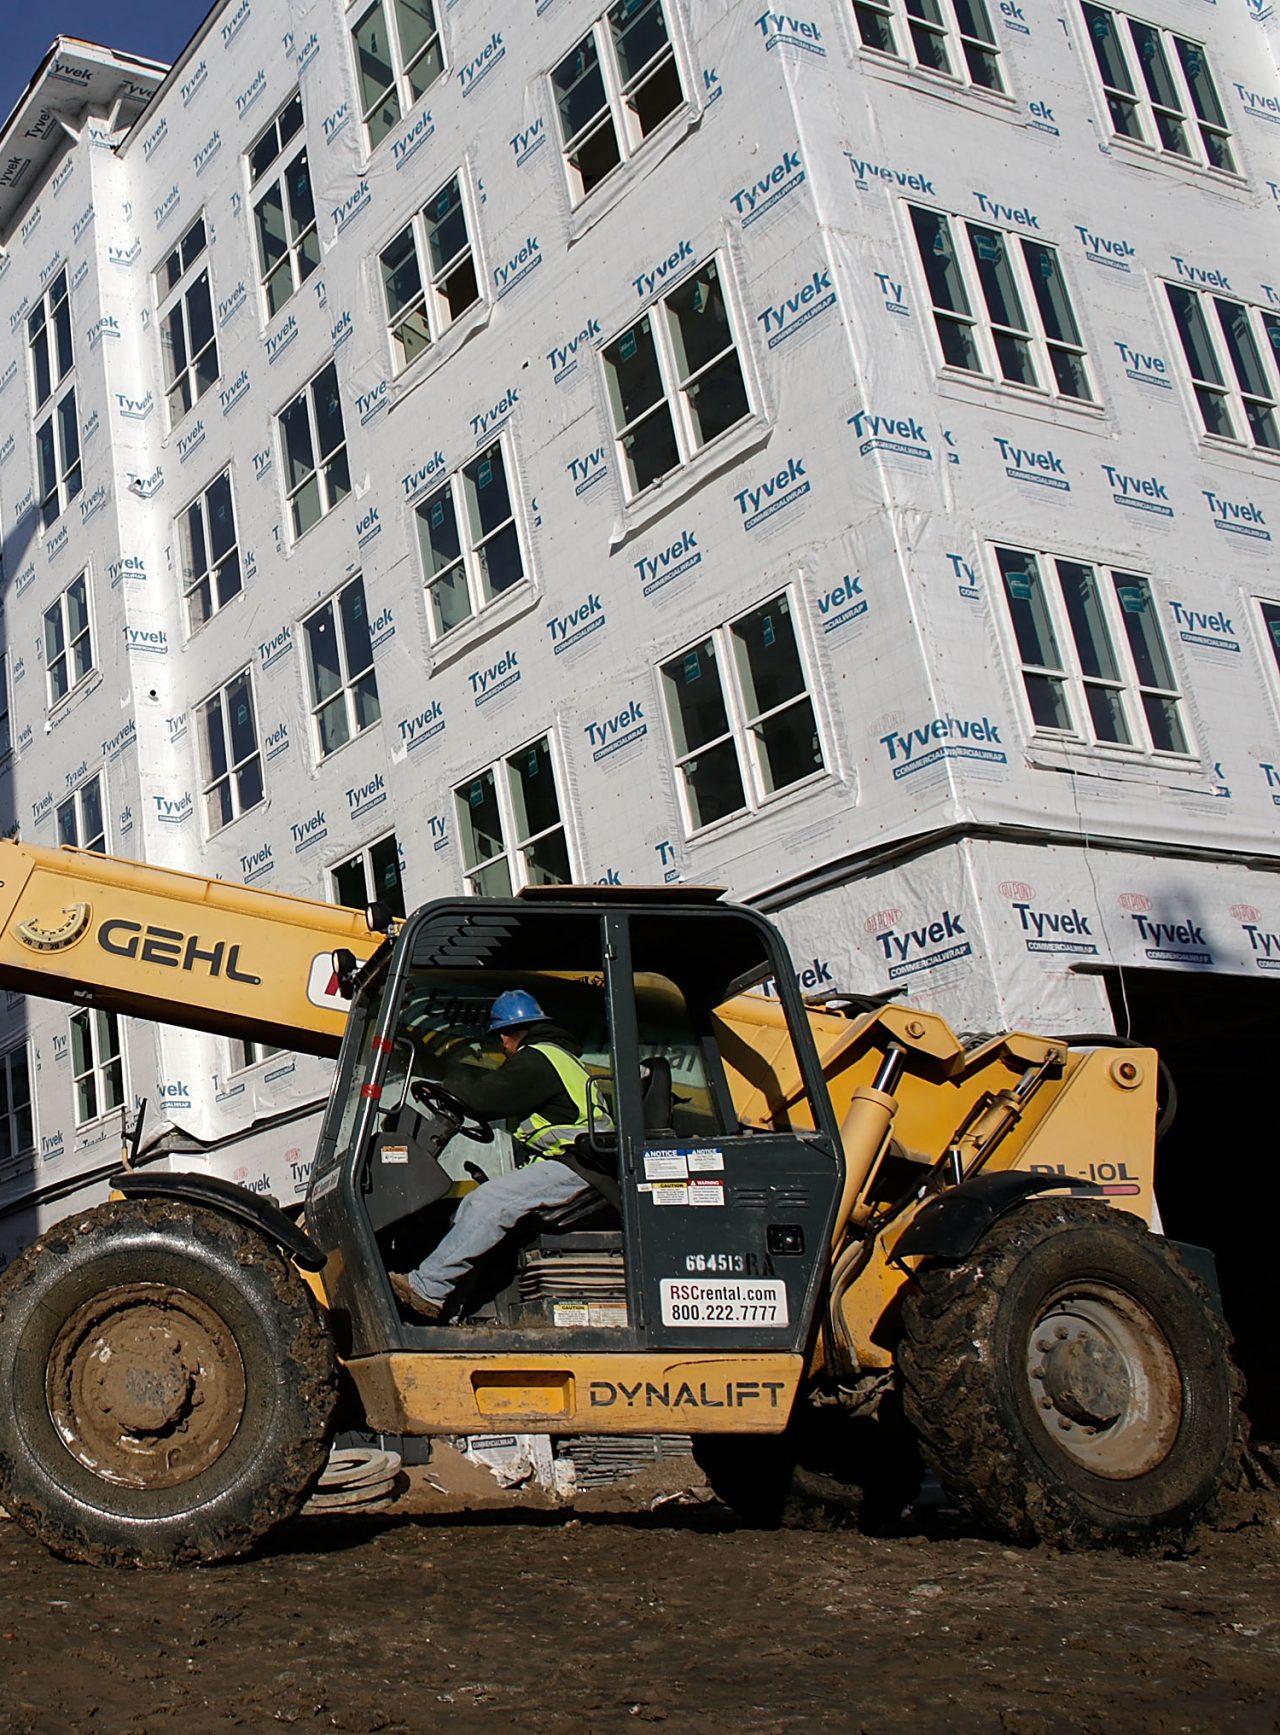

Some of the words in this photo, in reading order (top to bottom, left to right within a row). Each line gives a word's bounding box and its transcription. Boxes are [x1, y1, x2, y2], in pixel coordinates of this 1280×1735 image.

[755, 10, 822, 41] Tyvek
[456, 32, 504, 86] Tyvek
[180, 61, 207, 100] Tyvek
[236, 68, 265, 110] Tyvek
[193, 129, 220, 169] Tyvek
[391, 109, 433, 159] Tyvek
[730, 151, 801, 214] Tyvek
[154, 185, 180, 222] Tyvek
[331, 180, 370, 225] Tyvek
[972, 192, 1040, 230] Tyvek
[1075, 225, 1136, 257] Tyvek
[493, 237, 540, 287] Tyvek
[632, 240, 694, 297] Tyvek
[1171, 256, 1232, 290] Tyvek
[757, 271, 833, 333] Tyvek
[86, 316, 119, 343] Tyvek
[264, 314, 297, 354] Tyvek
[547, 318, 602, 371] Tyvek
[1114, 342, 1166, 373] Tyve
[115, 391, 152, 411] Tyvek
[220, 370, 248, 407] Tyvek
[470, 388, 521, 434] Tyvek
[847, 410, 928, 442] Tyvek
[176, 420, 204, 454] Tyvek
[401, 450, 445, 495] Tyvek
[993, 437, 1065, 474] Tyvek
[733, 457, 807, 514] Tyvek
[1101, 464, 1168, 500] Tyvek
[1202, 490, 1266, 525] Tyvek
[46, 525, 68, 554] Tyvek
[634, 530, 698, 582] Tyvek
[15, 562, 35, 590] Tyvek
[107, 556, 145, 579] Tyvek
[946, 553, 975, 586] Ty
[817, 575, 864, 614] vek
[546, 594, 603, 640] Tyvek
[1169, 601, 1235, 635] Tyvek
[122, 626, 167, 645] Tyvek
[259, 625, 291, 659] Tyvek
[469, 650, 518, 693] Tyvek
[398, 700, 443, 740] Tyvek
[584, 701, 645, 746] Tyvek
[32, 792, 54, 817] Tyvek
[154, 791, 192, 815] Tyvek
[346, 773, 385, 808] Tyvek
[290, 810, 326, 842] Tyvek
[427, 816, 445, 837] Ty
[240, 843, 272, 873] Tyvek
[876, 911, 966, 960] Tyvek
[1012, 903, 1092, 937] Tyvek
[1132, 914, 1207, 946] Tyvek
[97, 919, 261, 985] GEHL
[889, 942, 971, 980] COMMERCIALWRAP
[42, 1130, 64, 1151] Tyvek
[686, 1254, 744, 1272] 664513
[670, 1285, 776, 1301] RSCrental.com
[672, 1305, 777, 1321] 800.222.7777
[589, 1381, 785, 1407] DYNALIFT
